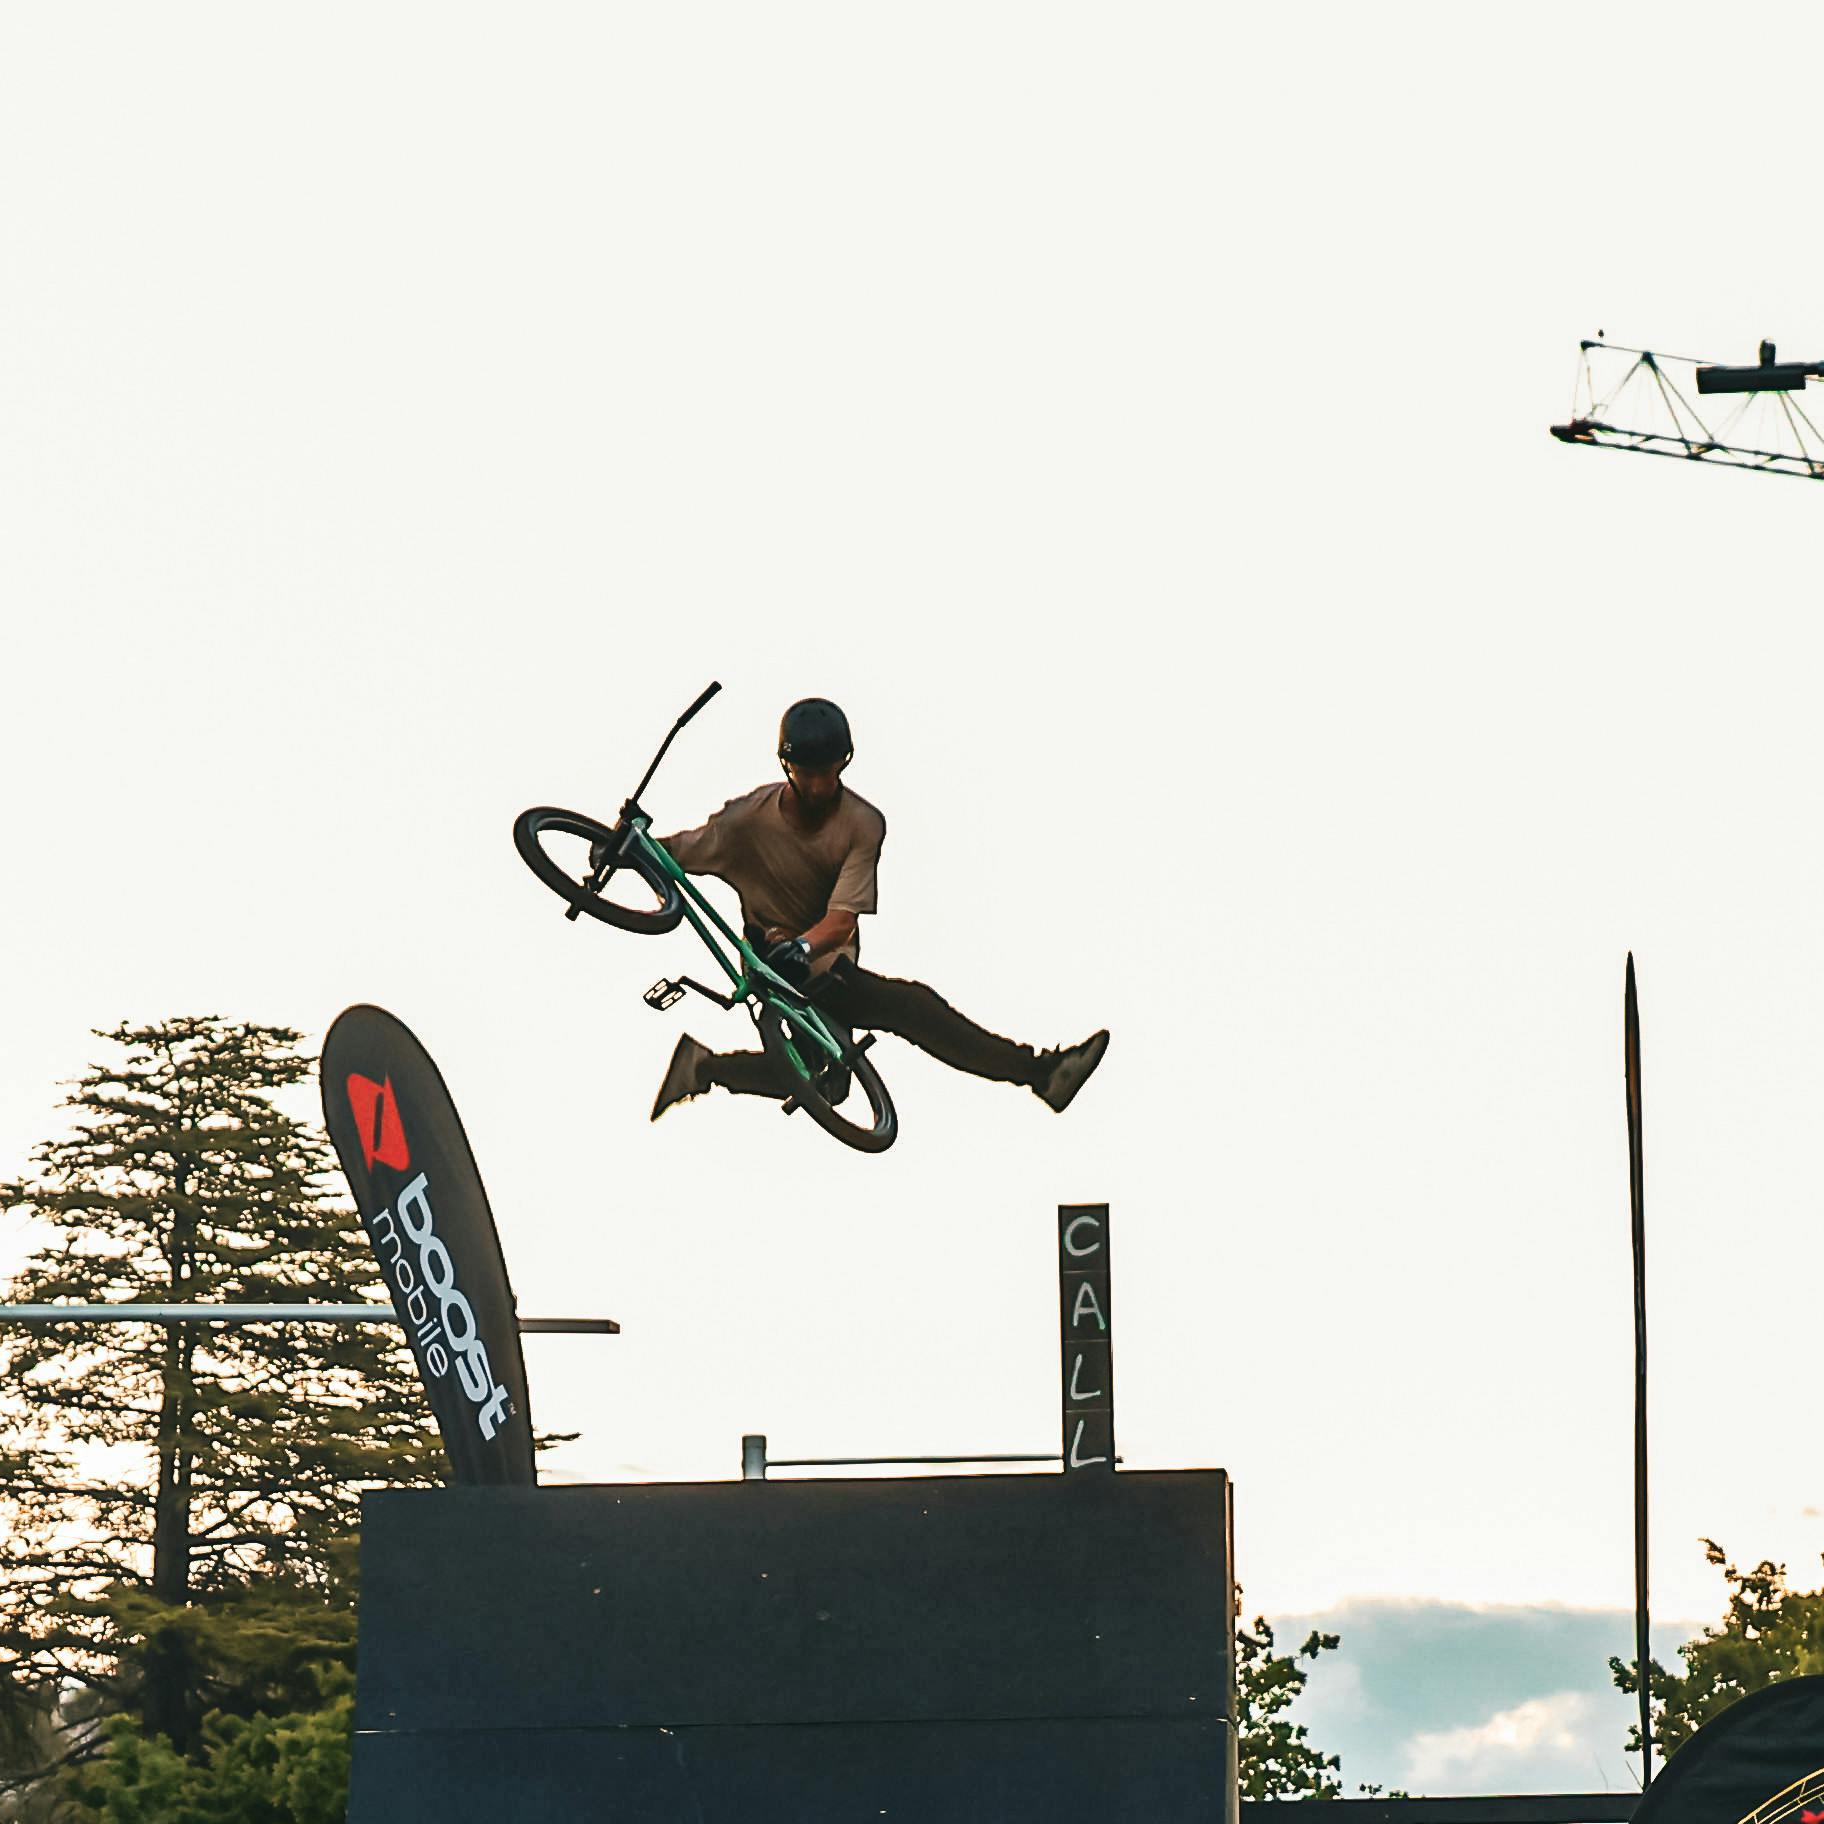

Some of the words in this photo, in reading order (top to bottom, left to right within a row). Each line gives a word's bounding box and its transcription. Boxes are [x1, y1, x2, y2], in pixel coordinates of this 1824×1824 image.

[372, 1208, 450, 1379] mobile
[397, 1172, 510, 1441] boost
[1063, 1215, 1107, 1468] CALL
